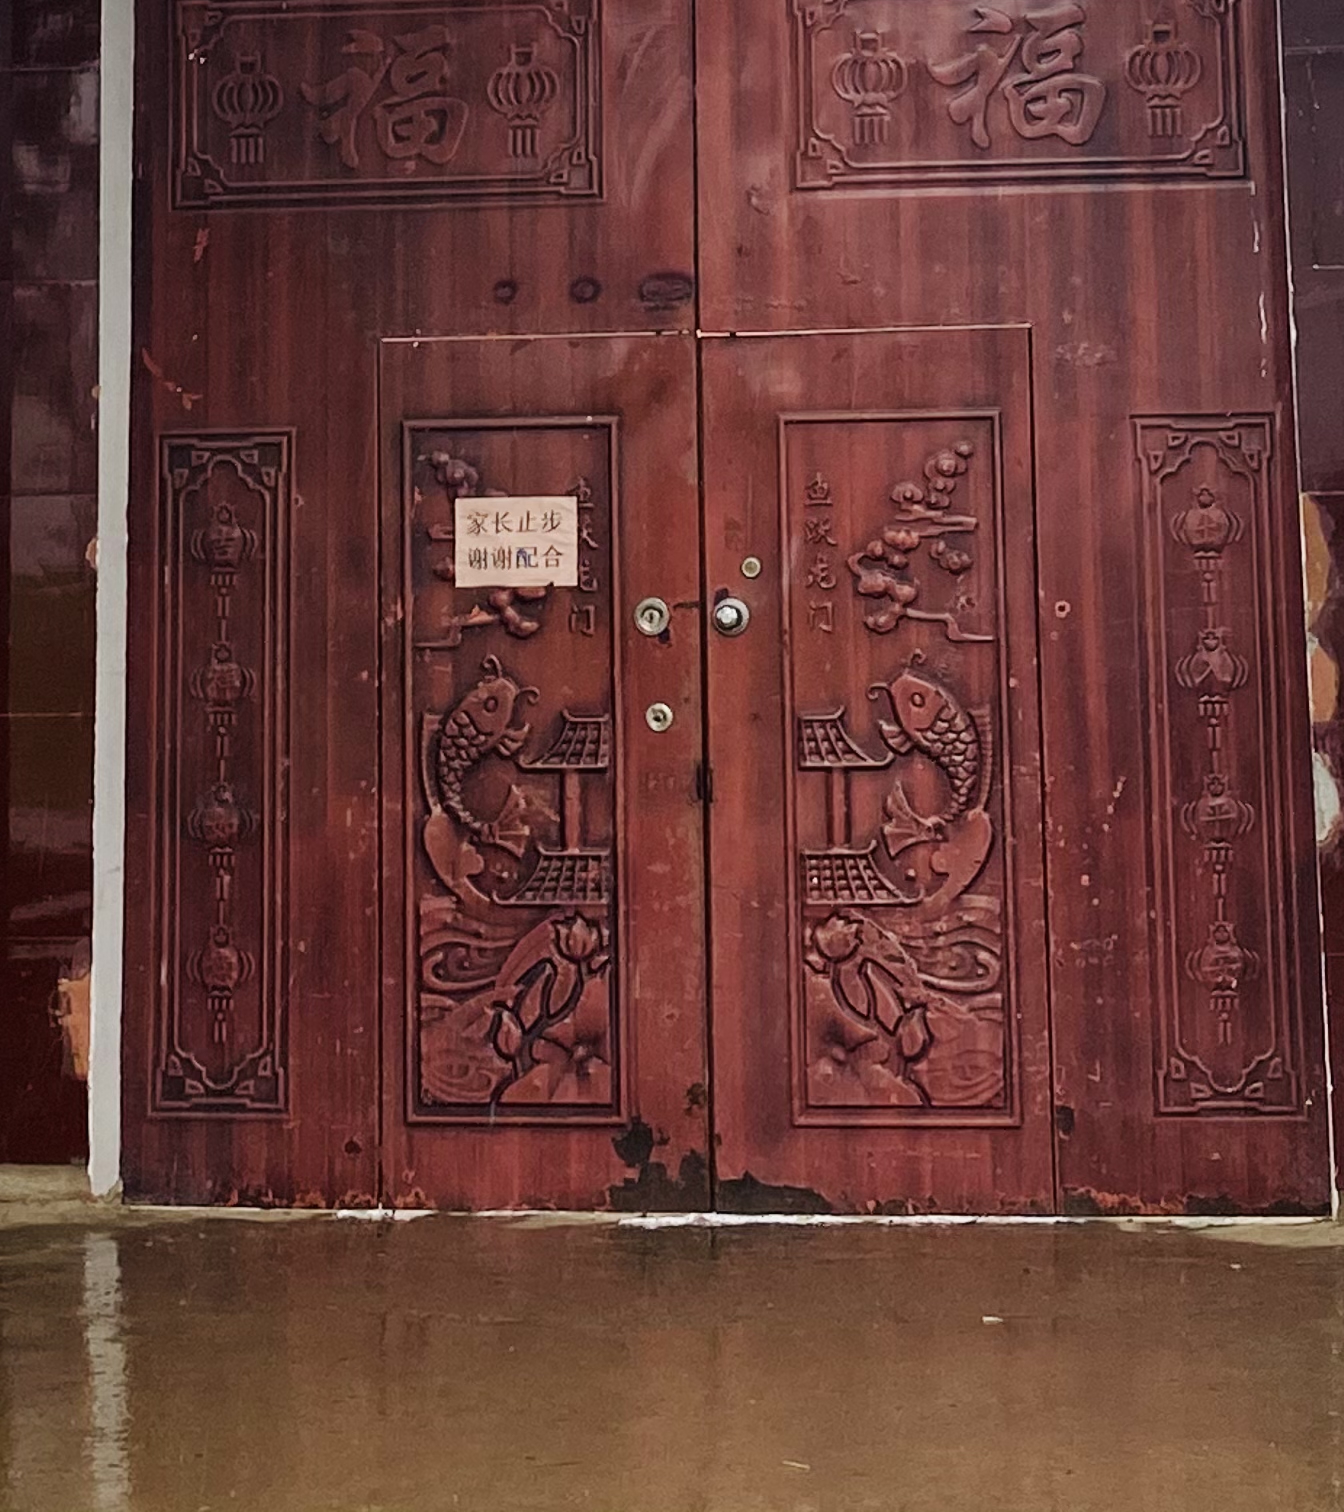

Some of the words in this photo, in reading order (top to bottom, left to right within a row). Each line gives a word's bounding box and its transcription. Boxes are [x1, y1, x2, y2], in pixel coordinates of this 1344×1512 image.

[926, 4, 1110, 150] 福
[467, 509, 563, 536] 家长止步
[468, 544, 564, 571] 谢谢配合
